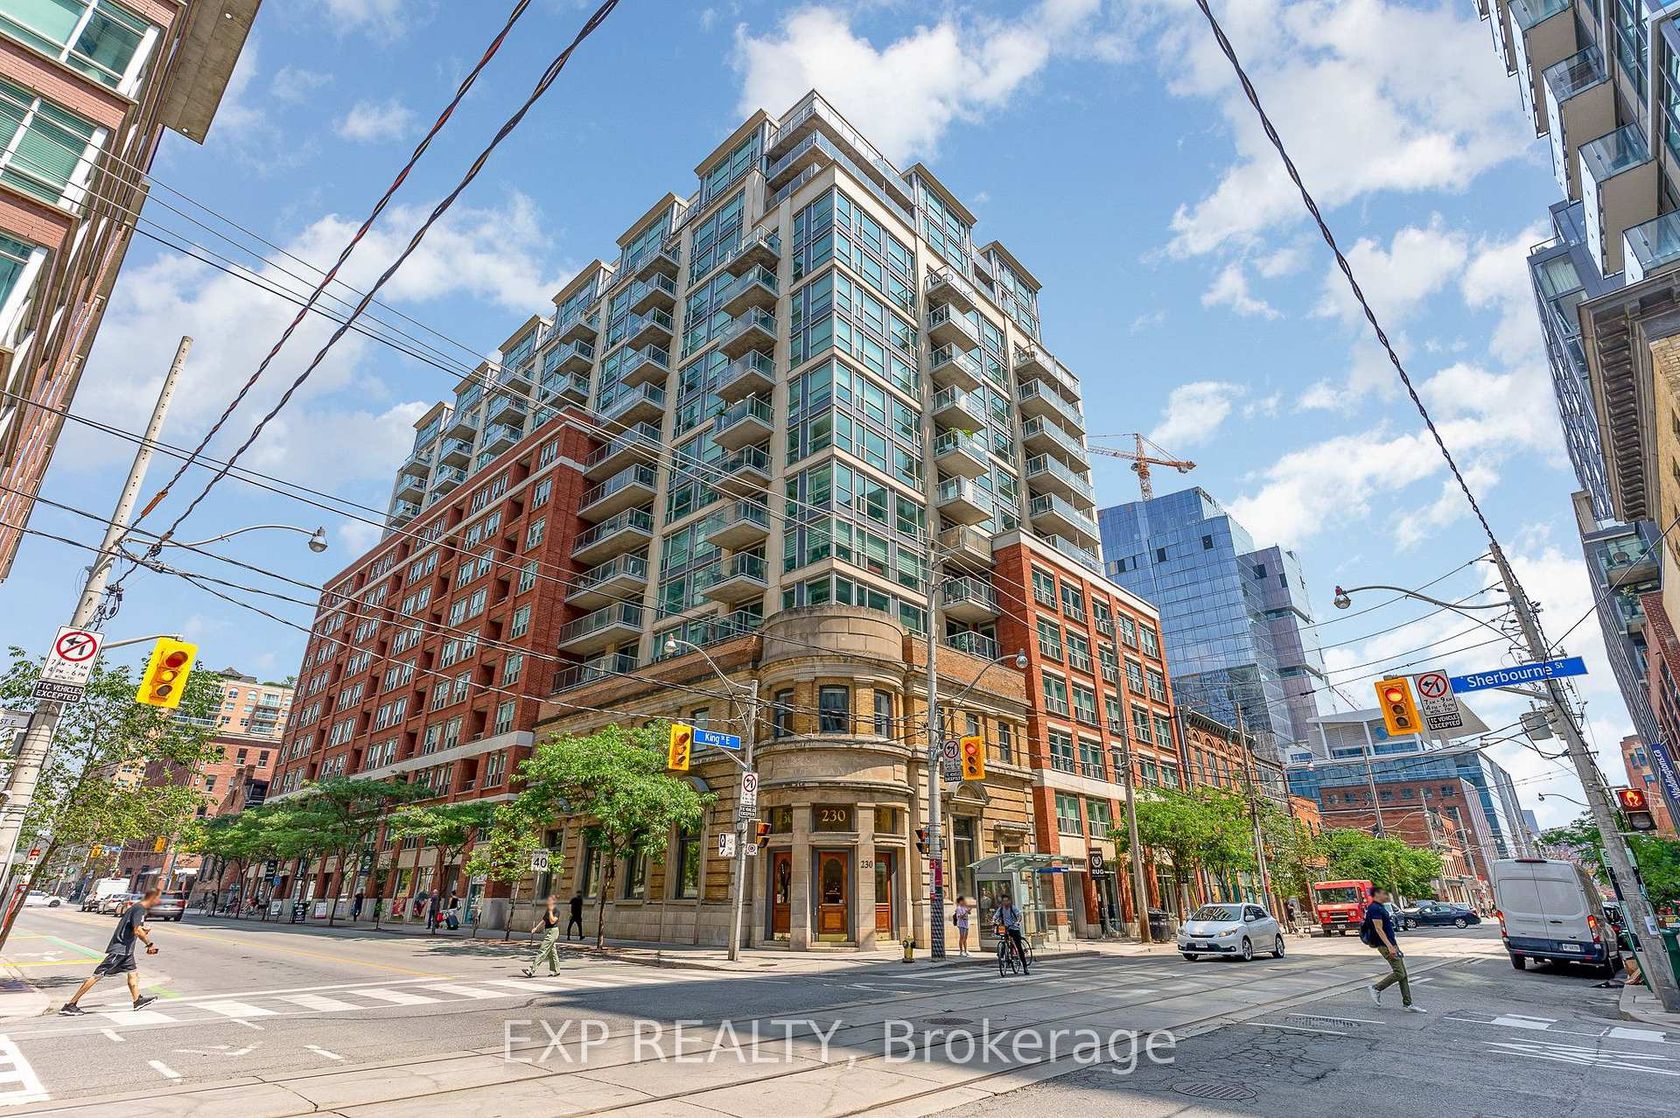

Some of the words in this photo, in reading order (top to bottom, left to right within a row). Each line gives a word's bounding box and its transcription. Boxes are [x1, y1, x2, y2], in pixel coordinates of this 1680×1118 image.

[1466, 665, 1553, 688] Sherbourne
[1555, 661, 1565, 669] St
[37, 682, 51, 690] TTC
[53, 684, 84, 695] VEHICLES
[35, 690, 79, 702] EXCEPTED
[1431, 720, 1461, 729] EXCEPTED
[705, 732, 720, 746] King
[726, 737, 731, 745] E
[821, 809, 846, 822] 230
[533, 857, 548, 868] 40
[860, 860, 873, 869] 230
